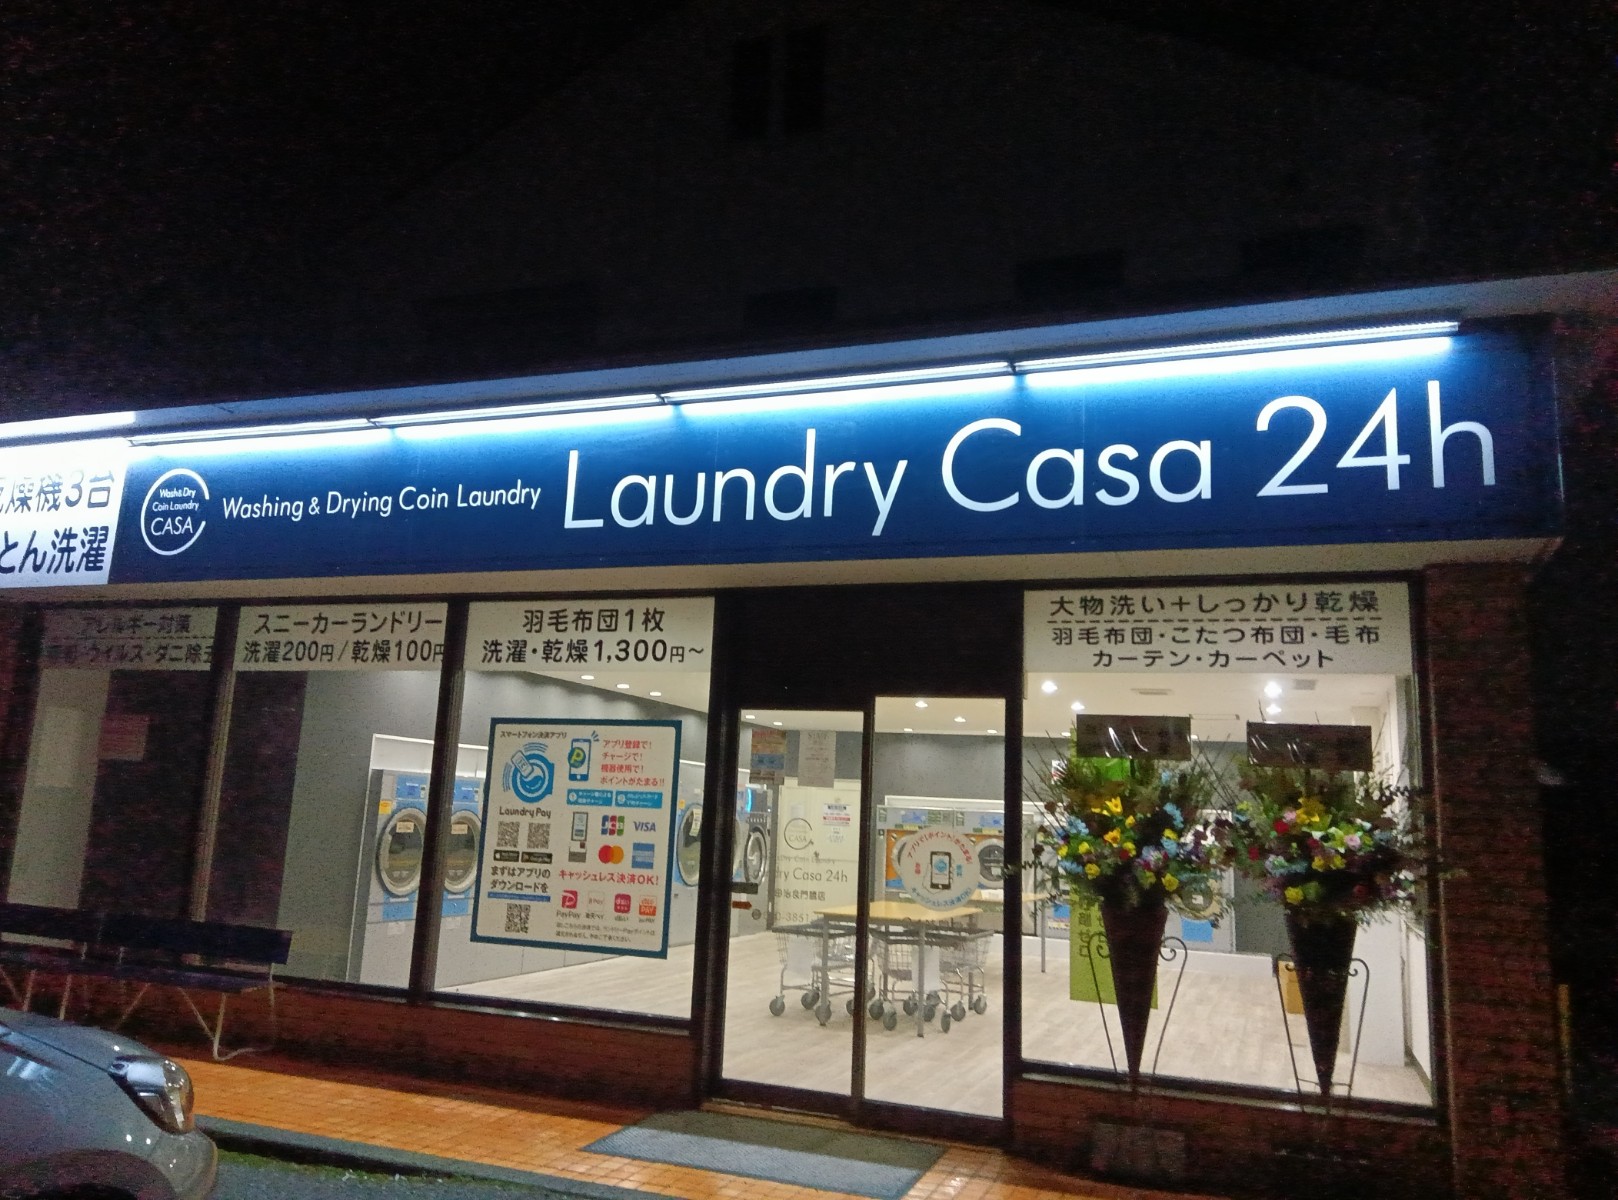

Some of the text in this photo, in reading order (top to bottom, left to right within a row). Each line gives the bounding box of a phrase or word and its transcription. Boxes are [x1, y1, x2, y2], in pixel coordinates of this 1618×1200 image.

[563, 380, 1496, 536] Laundry Casa 24h
[152, 500, 199, 511] Coin Laundry
[222, 479, 541, 522] Washing & Drying Coin Laundry
[151, 516, 193, 536] CASA
[0, 526, 110, 574] とん洗濯
[254, 610, 443, 634] スニーカーランドリー
[522, 606, 666, 633] 羽毛布団1枚
[1051, 625, 1380, 646] 羽毛布団・こたつ布団・毛布
[1093, 649, 1335, 668] カーテン・カーペット
[499, 806, 552, 819] Laundry Pay
[633, 821, 657, 832] VISA
[491, 865, 551, 879] まずはアプリの
[792, 867, 822, 881] Casa
[825, 869, 848, 882] 24h
[490, 879, 549, 893] ダウンロードを
